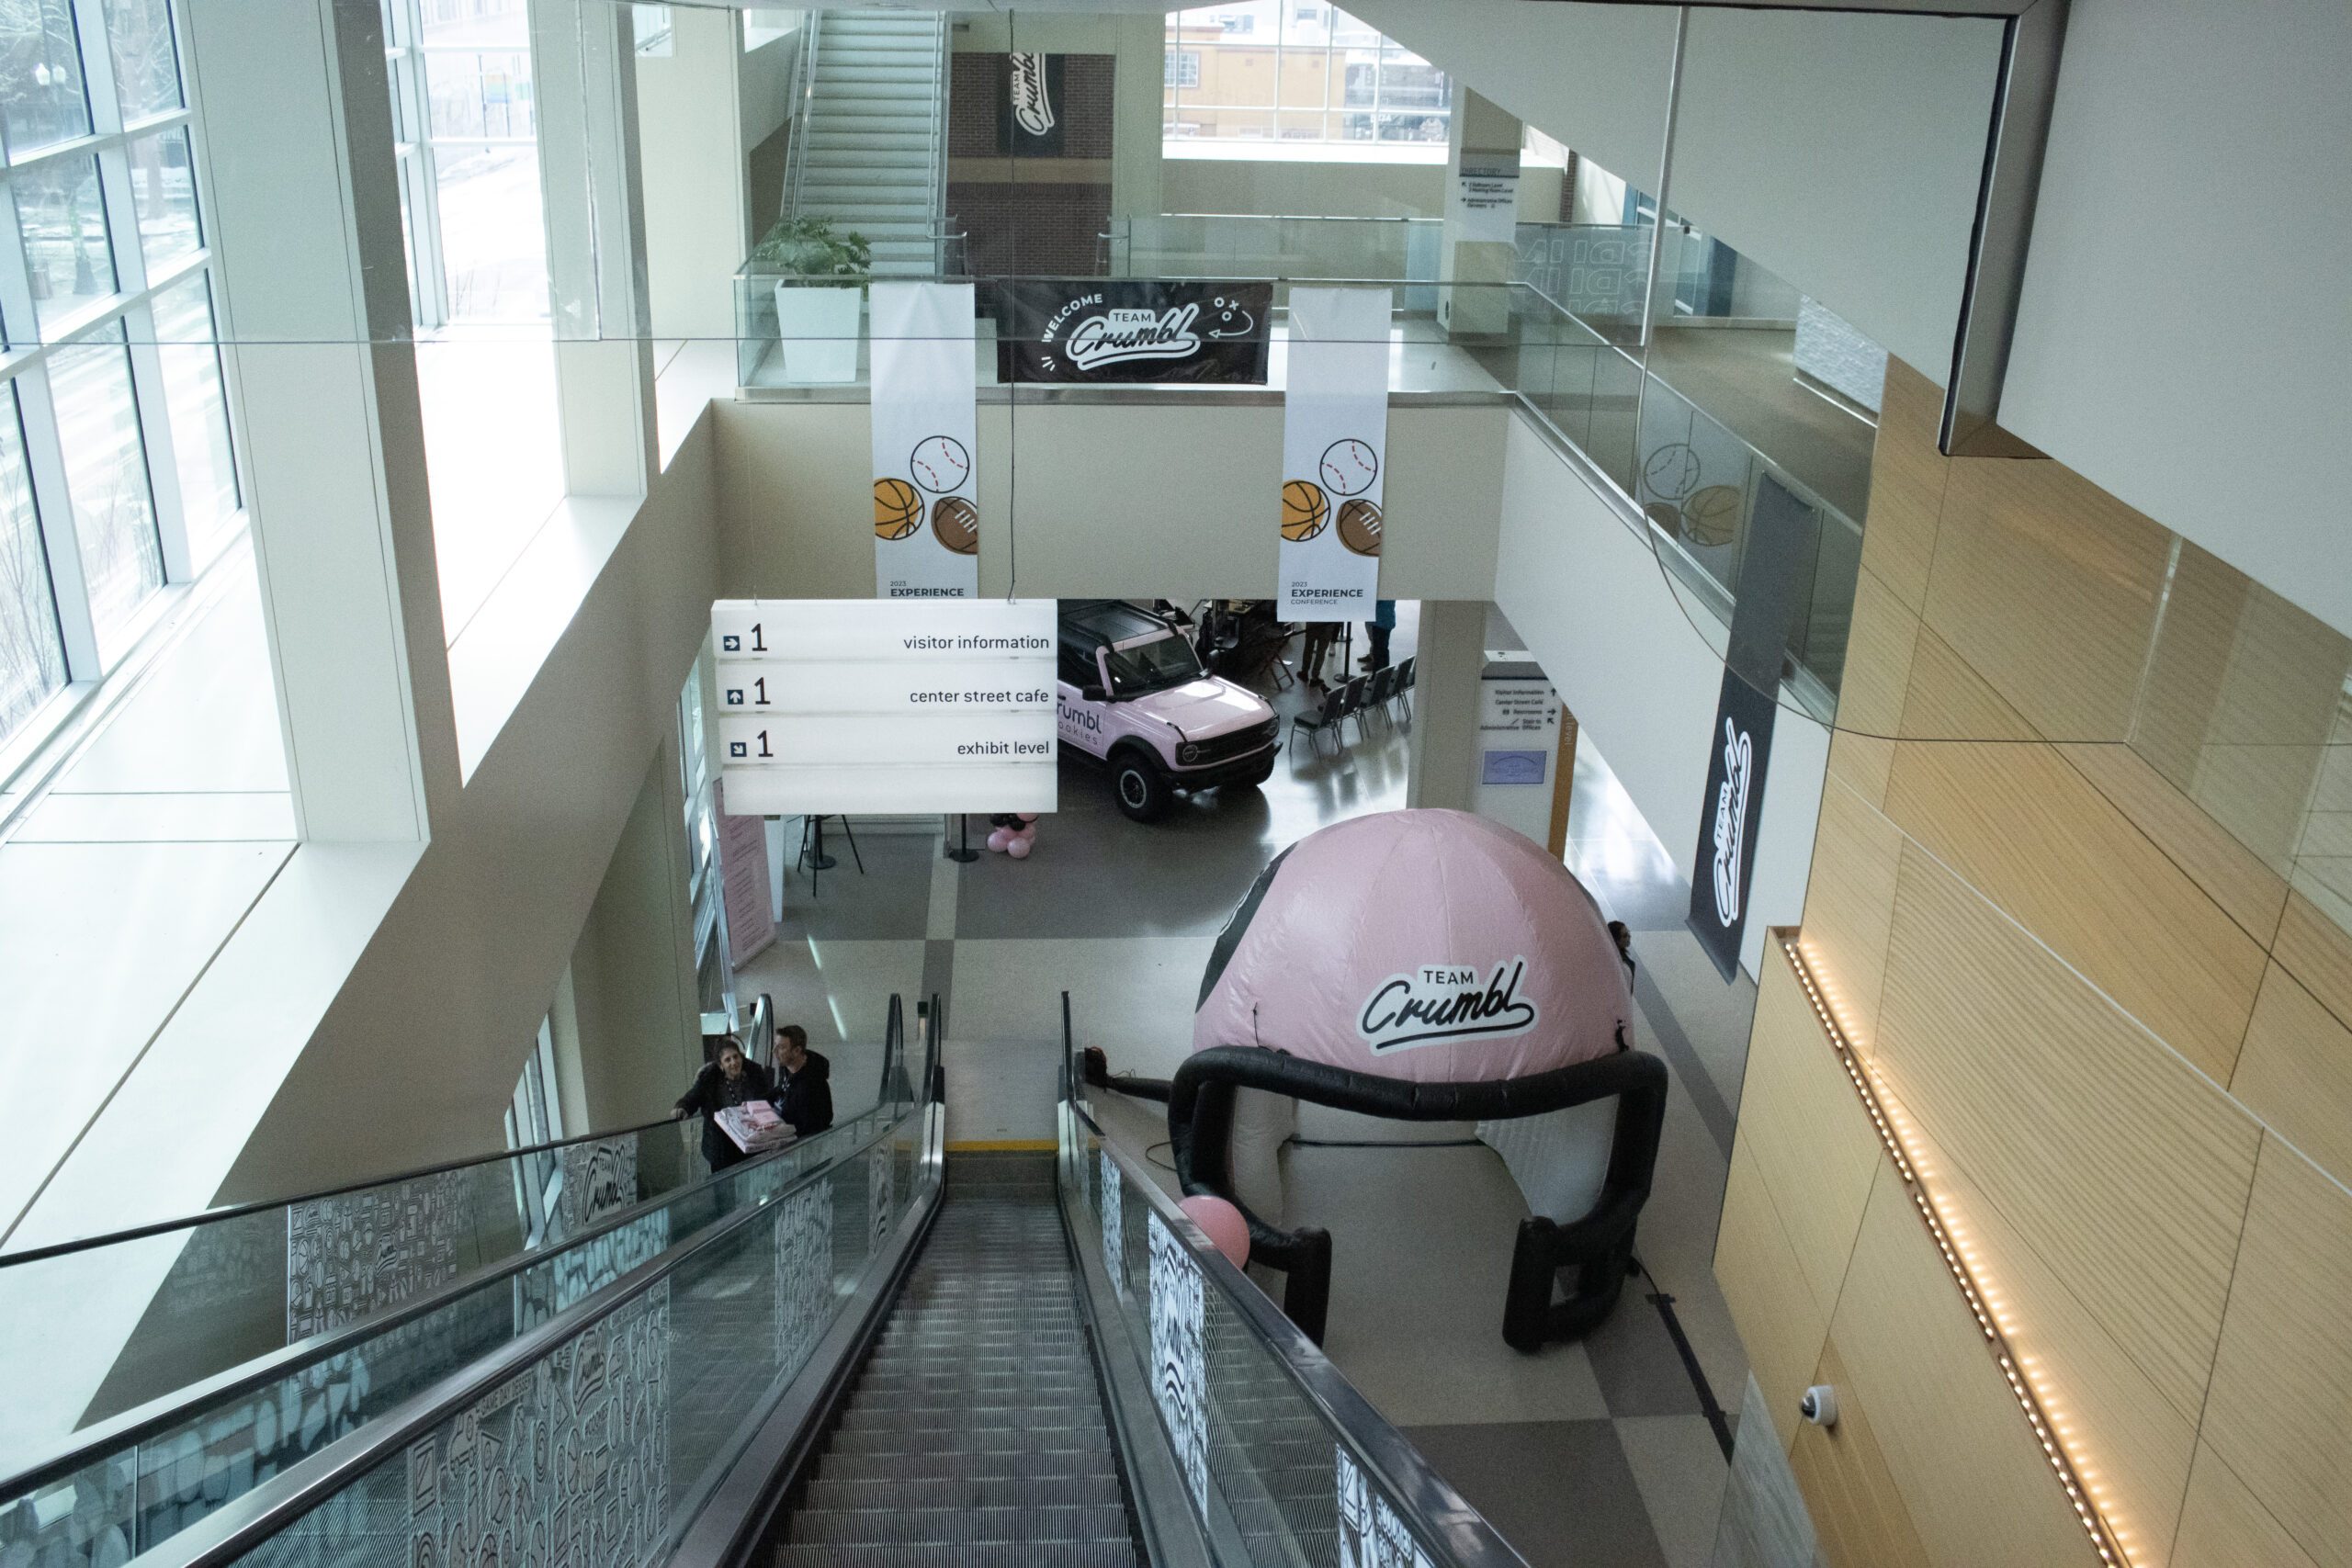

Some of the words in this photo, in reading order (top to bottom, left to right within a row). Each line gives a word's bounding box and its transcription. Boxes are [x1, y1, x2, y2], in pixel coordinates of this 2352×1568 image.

[1042, 293, 1102, 343] WELCOME
[1114, 312, 1151, 322] TEAM
[1071, 308, 1195, 366] Crumbl
[890, 588, 964, 597] EXPERIENCE
[1292, 589, 1363, 597] EXPERIENCE
[752, 624, 767, 651] 1
[904, 636, 954, 649] visitor
[957, 636, 1049, 649] information
[754, 677, 770, 705] 1
[910, 690, 959, 703] center
[964, 690, 1011, 703] street
[1015, 690, 1049, 703] cafe
[1057, 702, 1102, 734] rumbl
[757, 730, 774, 757] 1
[957, 741, 1010, 755] exhibit
[1014, 741, 1049, 754] level
[1058, 722, 1098, 745] ookies
[1716, 788, 1727, 839] TEAM
[1716, 724, 1749, 920] Crumbl
[1424, 970, 1473, 985] TEAM
[1363, 962, 1534, 1049] Crumbl
